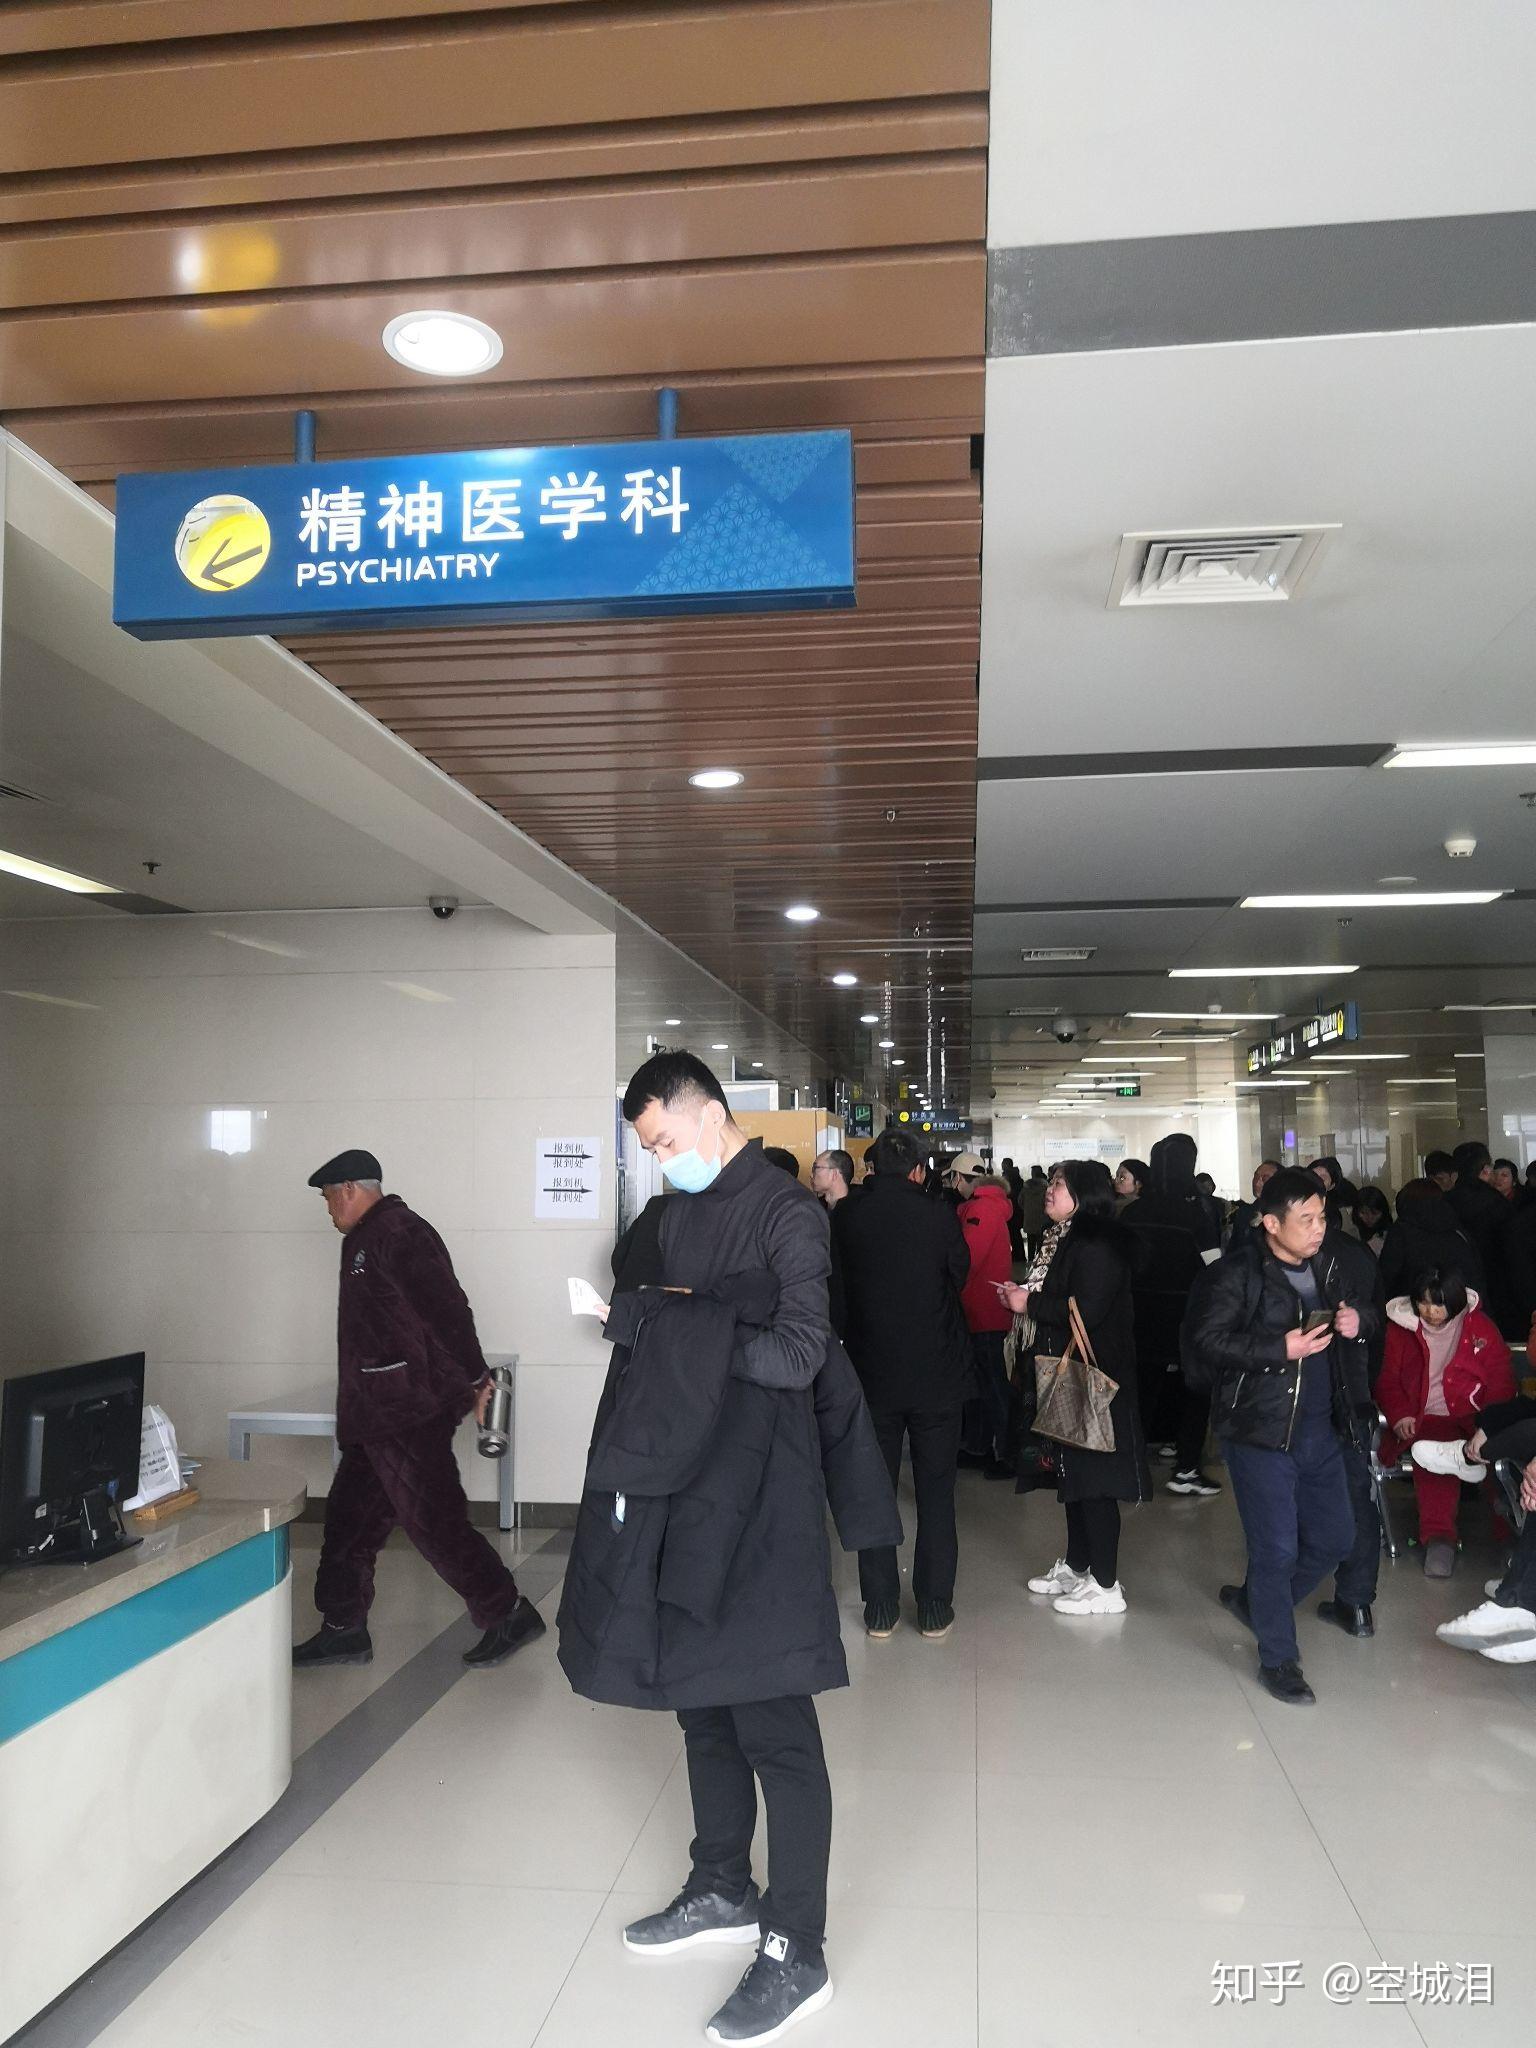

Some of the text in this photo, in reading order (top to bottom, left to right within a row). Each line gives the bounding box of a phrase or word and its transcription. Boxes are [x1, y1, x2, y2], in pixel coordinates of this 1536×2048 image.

[298, 465, 690, 553] 精神医学科
[296, 552, 500, 587] PSYCHIATRY
[554, 1142, 585, 1154] 报到机
[553, 1157, 584, 1168] 报到处
[552, 1177, 584, 1188] 报到机
